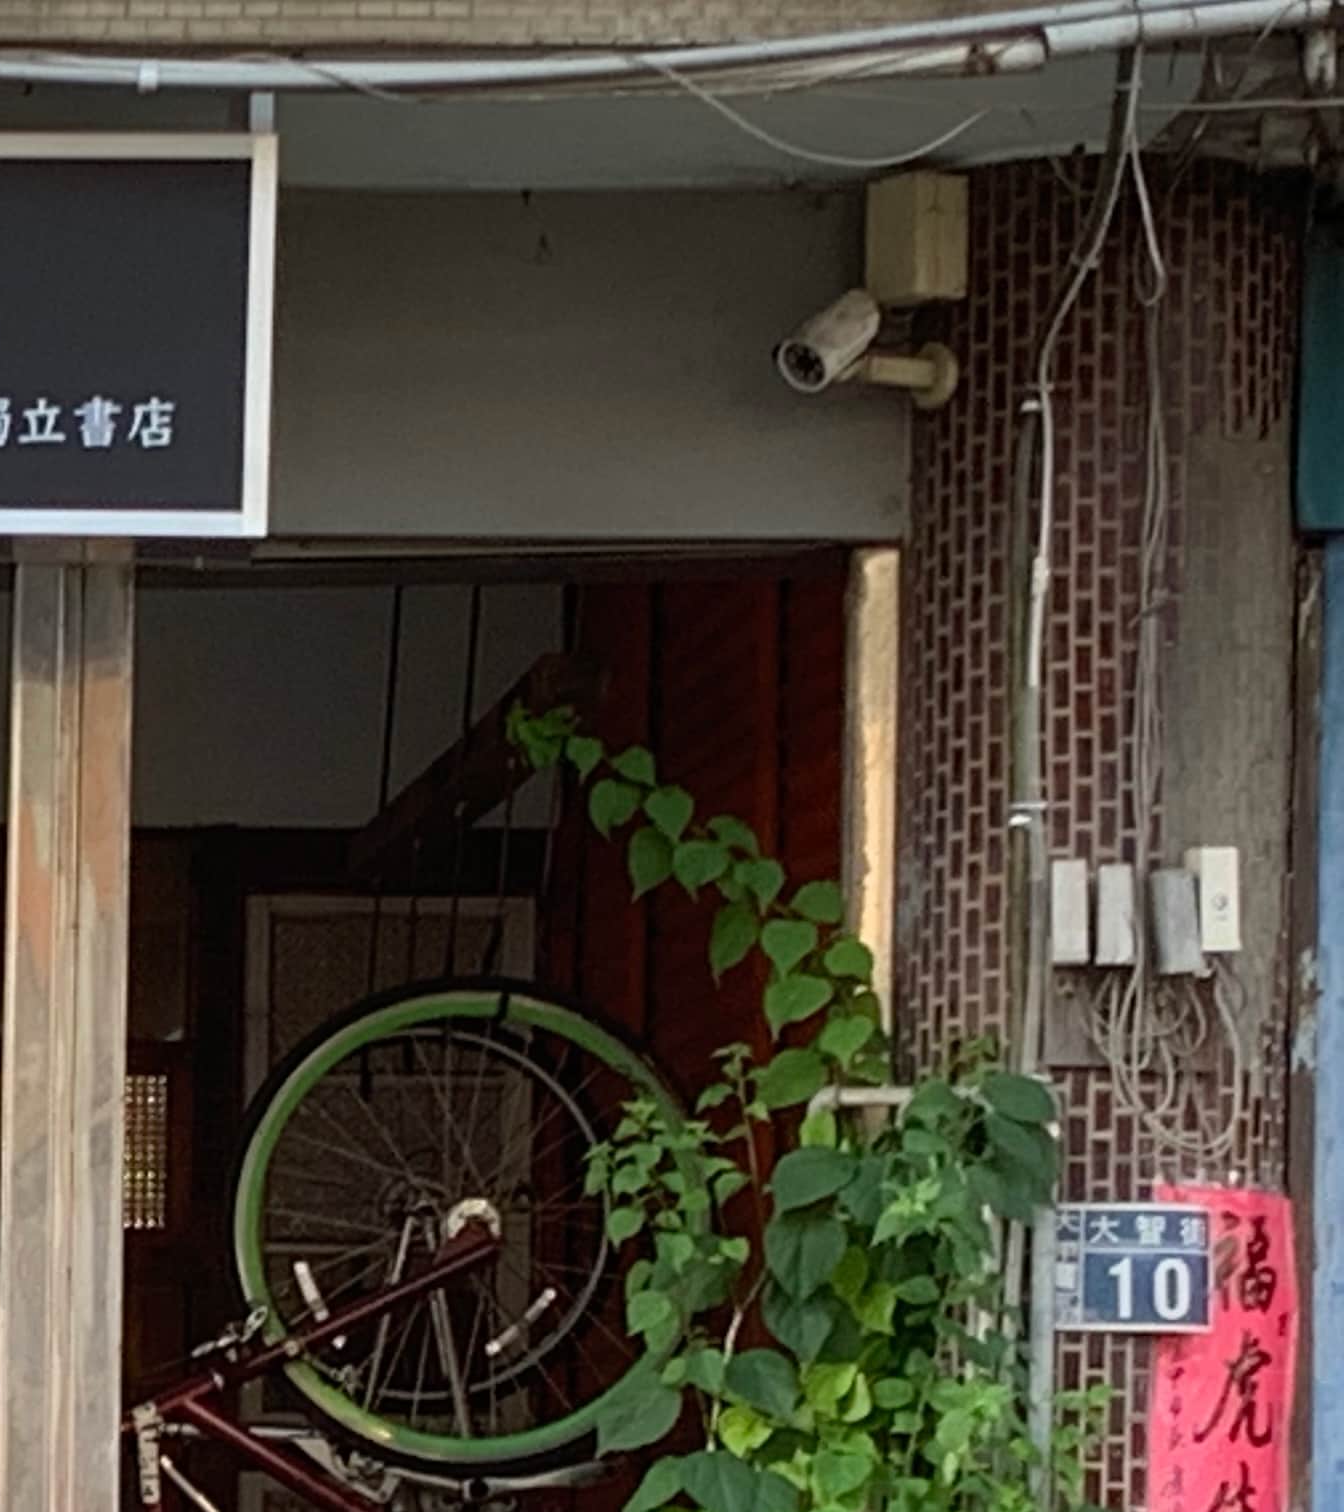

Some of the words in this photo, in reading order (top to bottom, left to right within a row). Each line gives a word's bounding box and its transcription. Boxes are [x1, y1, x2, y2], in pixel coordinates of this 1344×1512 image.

[1088, 1213, 1207, 1247] 大智街
[1108, 1257, 1191, 1321] 10
